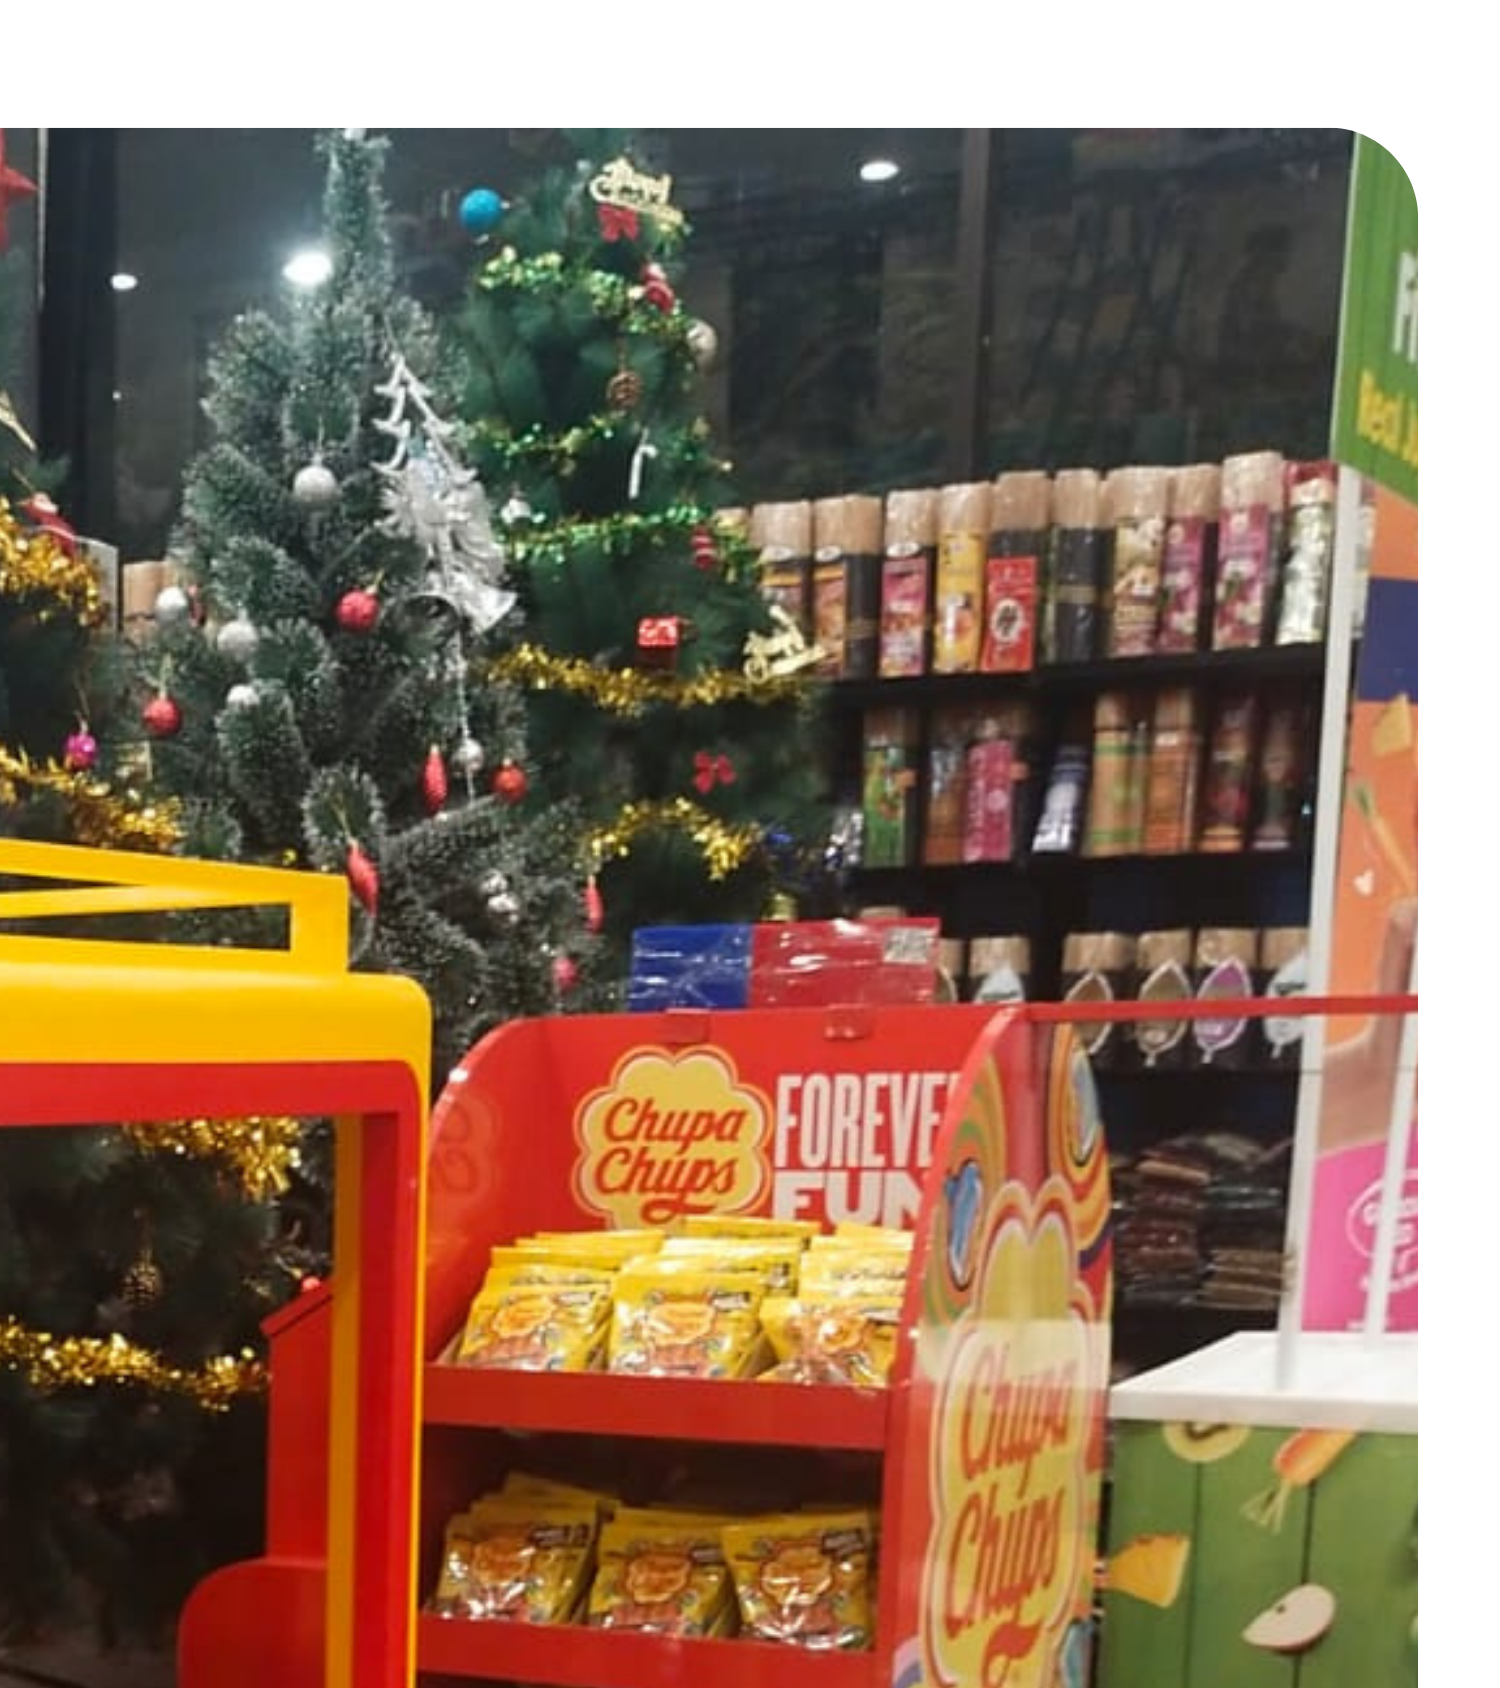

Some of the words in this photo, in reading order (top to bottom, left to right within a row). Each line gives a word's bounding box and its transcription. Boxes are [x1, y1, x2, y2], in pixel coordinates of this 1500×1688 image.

[603, 1097, 749, 1155] Chupa
[775, 1072, 962, 1169] FOREVE
[594, 1146, 739, 1224] Chups
[961, 1342, 1072, 1500] Chupa
